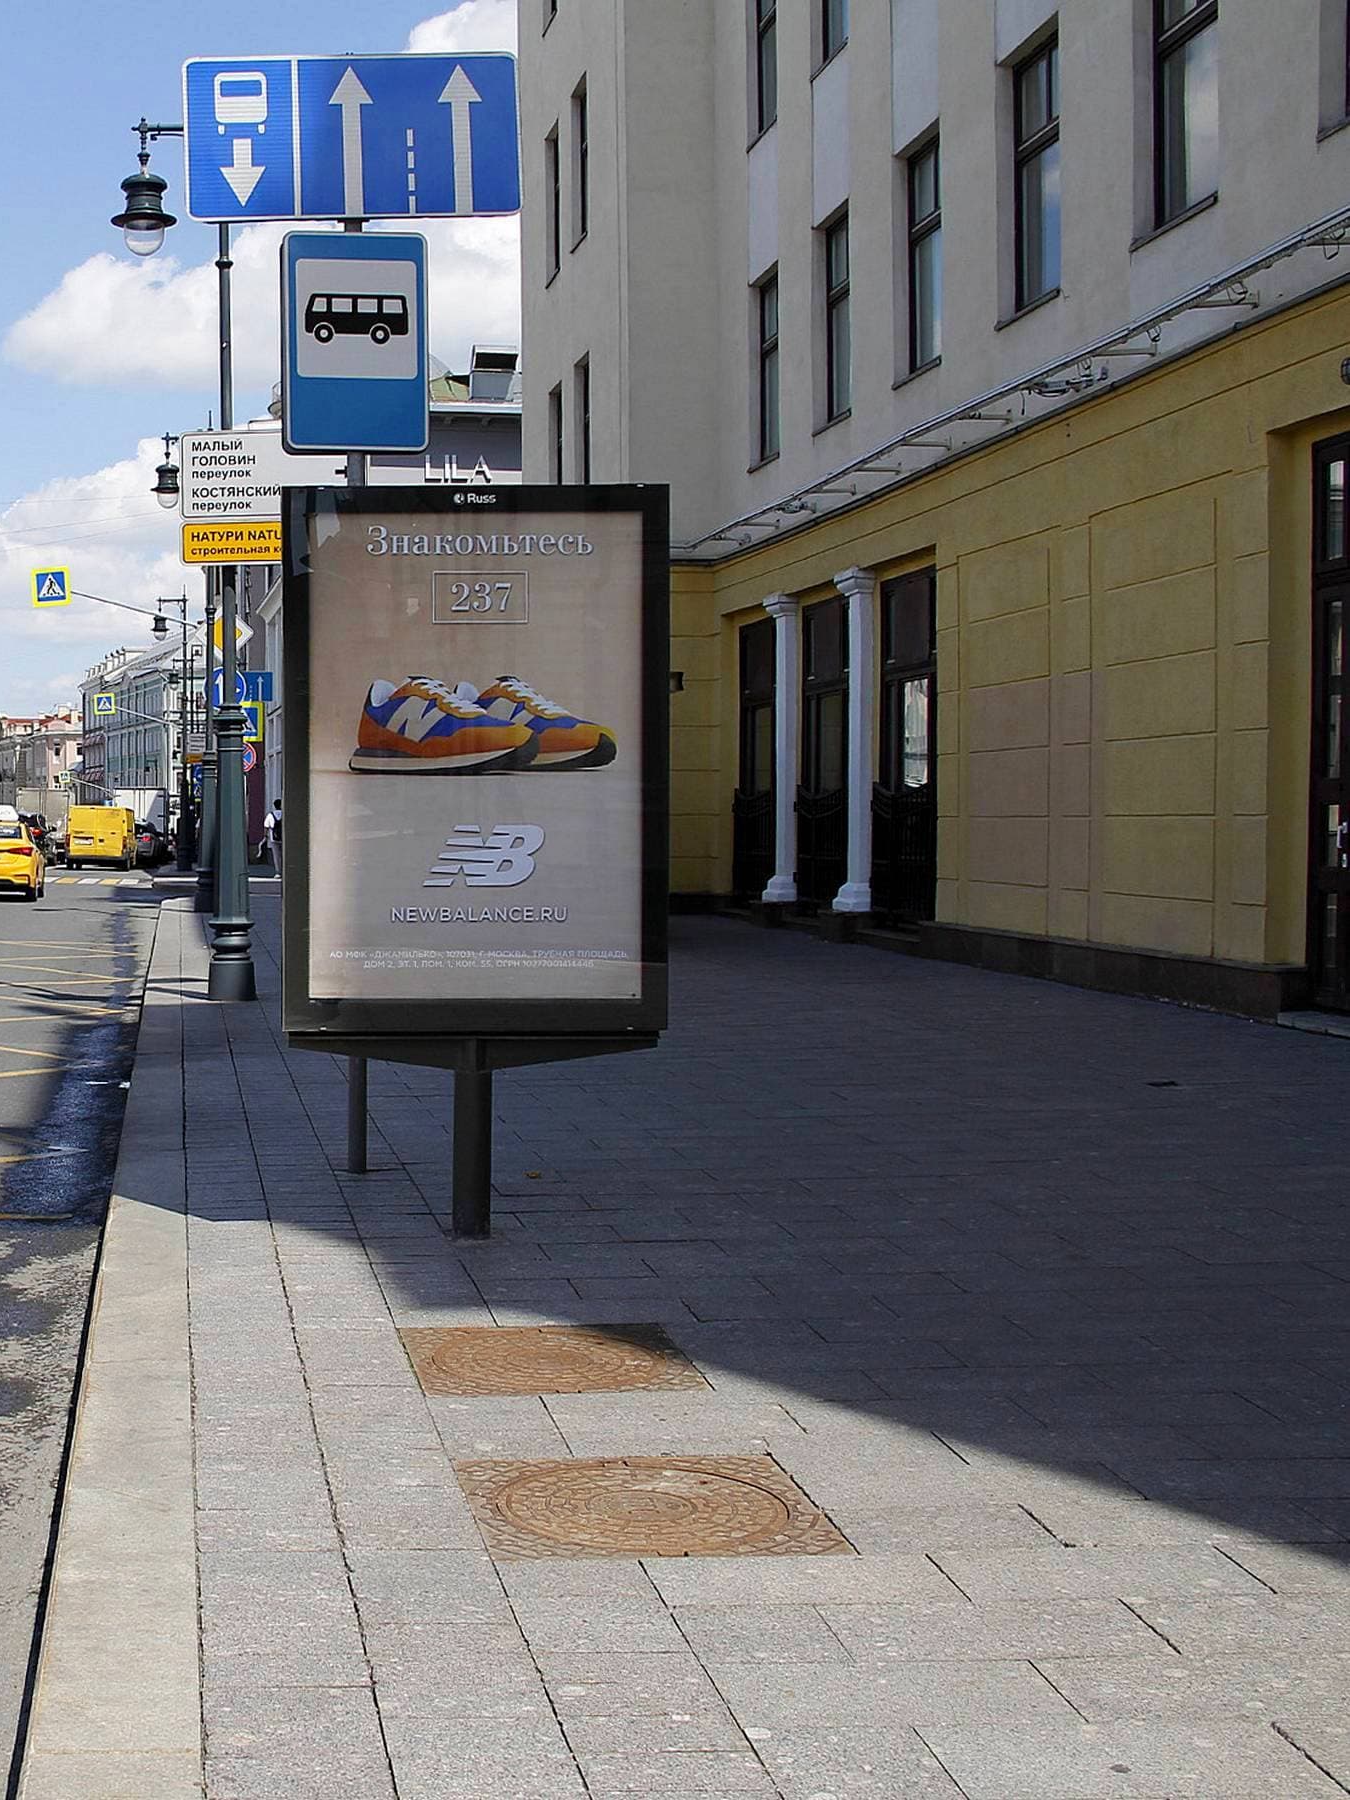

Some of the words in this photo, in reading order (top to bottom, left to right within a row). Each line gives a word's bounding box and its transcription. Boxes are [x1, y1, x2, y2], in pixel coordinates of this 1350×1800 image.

[191, 438, 243, 452] МАЛЫЙ
[191, 455, 256, 467] ГОЛОВИН
[424, 454, 493, 483] LILA
[191, 469, 252, 481] переулок
[191, 484, 281, 498] КОСТЯНСКИЙ
[467, 493, 497, 504] Russ
[191, 501, 253, 512] переулок
[191, 530, 244, 542] НАТУРИ
[366, 525, 594, 557] Знакомьтесь
[191, 546, 271, 557] строительная
[450, 582, 513, 613] 237
[391, 906, 569, 923] NEWBALANCE.RU
[330, 950, 343, 959] АО
[363, 960, 386, 969] ДОМ
